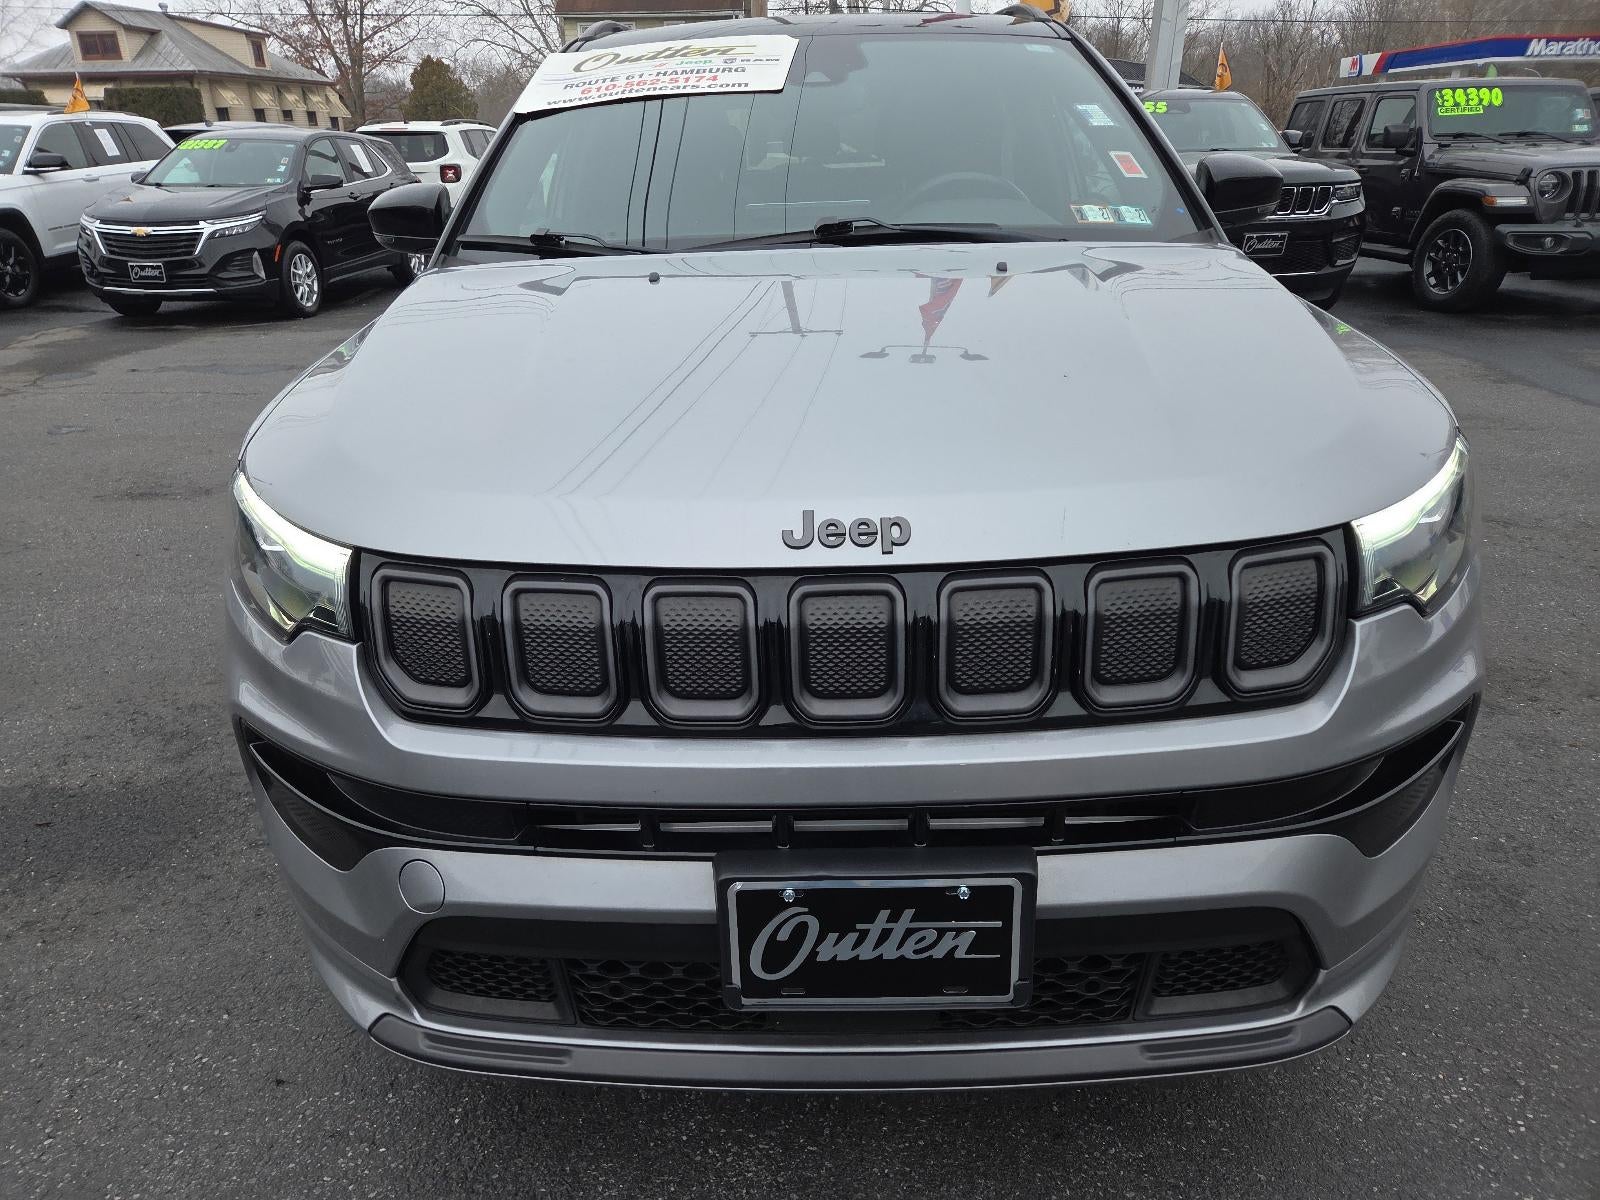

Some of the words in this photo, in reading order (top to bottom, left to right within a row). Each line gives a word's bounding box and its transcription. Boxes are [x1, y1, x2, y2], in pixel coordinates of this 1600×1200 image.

[573, 44, 757, 73] Outten
[563, 75, 621, 90] ROUTE
[625, 71, 644, 81] 61
[655, 66, 747, 77] HAMBURG
[580, 74, 719, 95] 610-562-5174
[546, 82, 750, 106] www.outtencars.com
[1435, 87, 1503, 107] $34390
[1439, 106, 1482, 114] CERTIFIED
[781, 509, 912, 555] Jeep
[749, 906, 1003, 981] Outten
